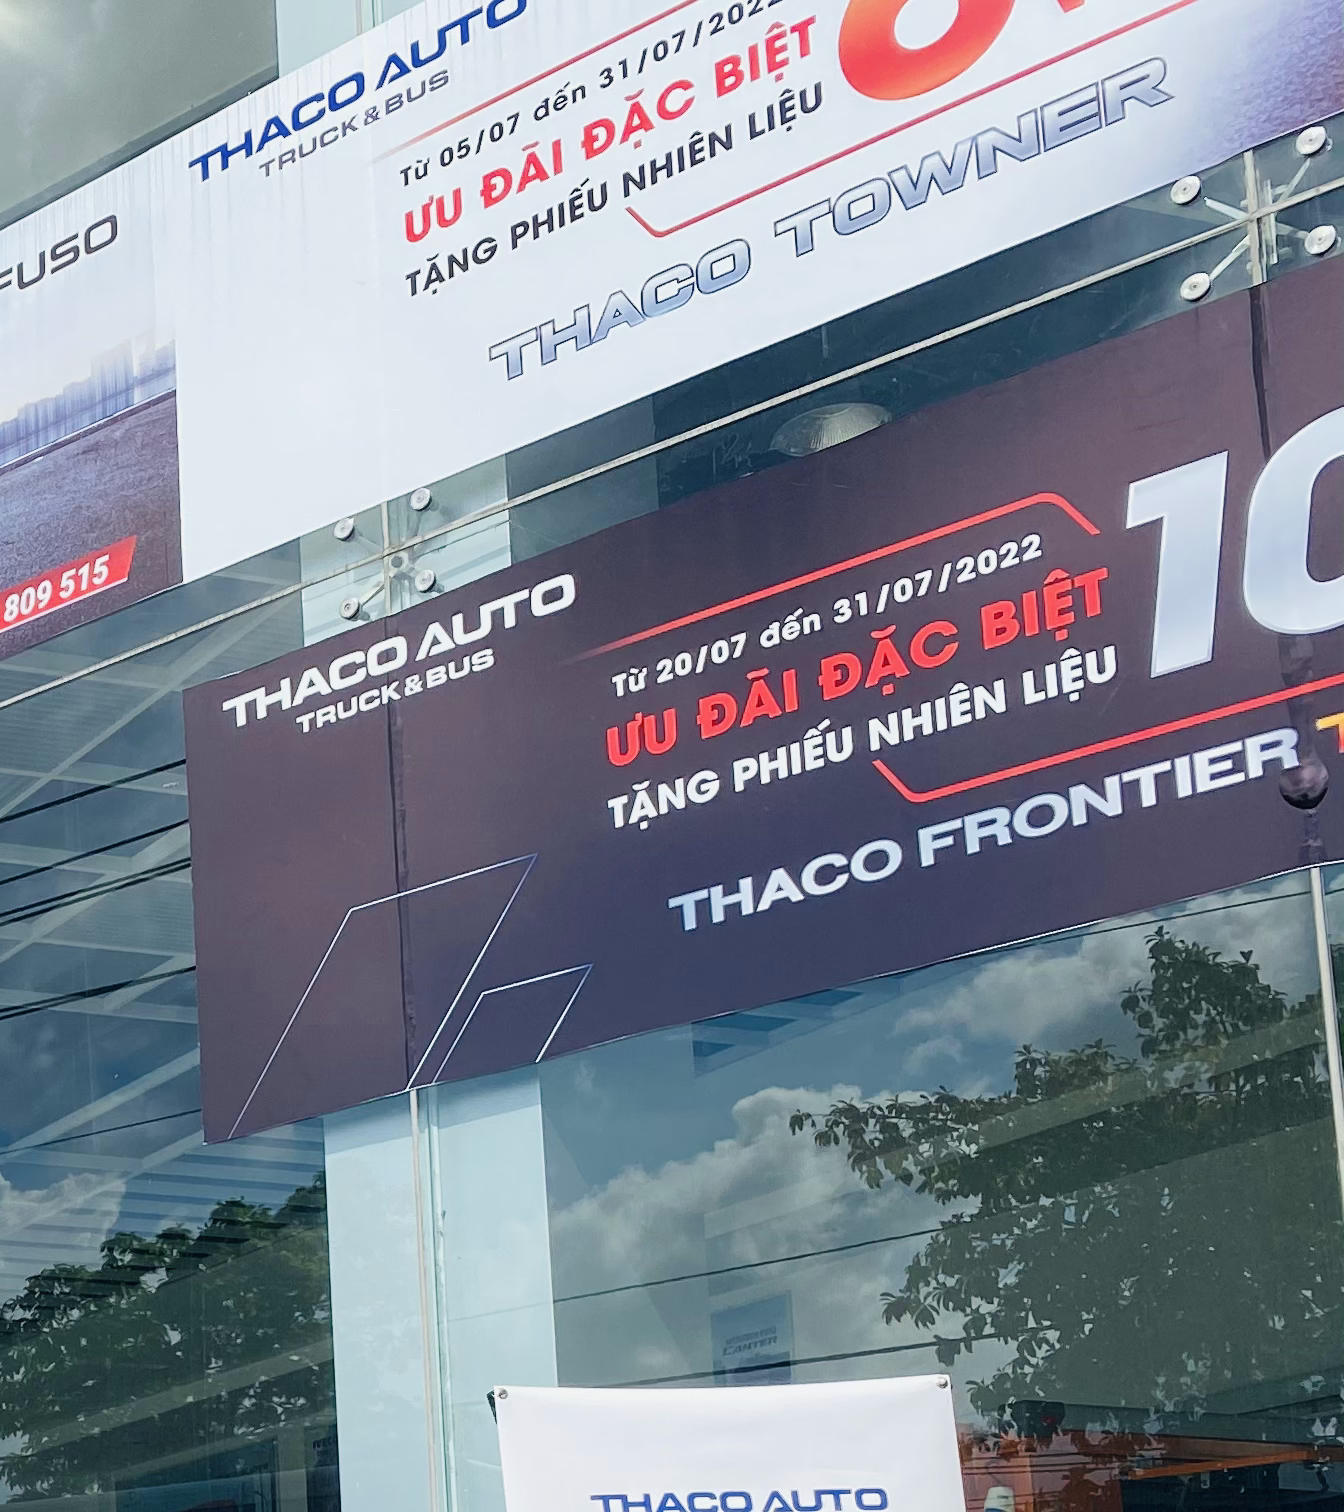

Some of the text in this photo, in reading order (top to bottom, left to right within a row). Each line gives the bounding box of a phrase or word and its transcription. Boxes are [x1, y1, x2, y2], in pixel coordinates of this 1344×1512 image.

[188, 0, 527, 183] THACO AUTO
[404, 187, 462, 244] ƯU
[480, 138, 563, 209] ĐÃI
[581, 79, 697, 160] ĐẶC
[713, 14, 817, 98] BIỆT
[440, 113, 520, 168] 05/07
[533, 77, 587, 121] đến
[405, 81, 824, 298] TẶNG PHIẾU NHIÊN LIỆU
[488, 56, 1175, 381] THACO TOWNER
[3, 579, 53, 623] 809
[59, 553, 110, 599] 515
[222, 573, 576, 728] THACO AUTO
[606, 566, 1111, 767] ƯU ĐÃI ĐẶC BIỆT
[612, 533, 1044, 698] Từ 20/07 đến 31/07/2022
[607, 644, 1118, 830] TẶNG PHIẾU NHIÊN LIỆU
[668, 839, 903, 931] THACO
[916, 727, 1300, 867] FRONTIER
